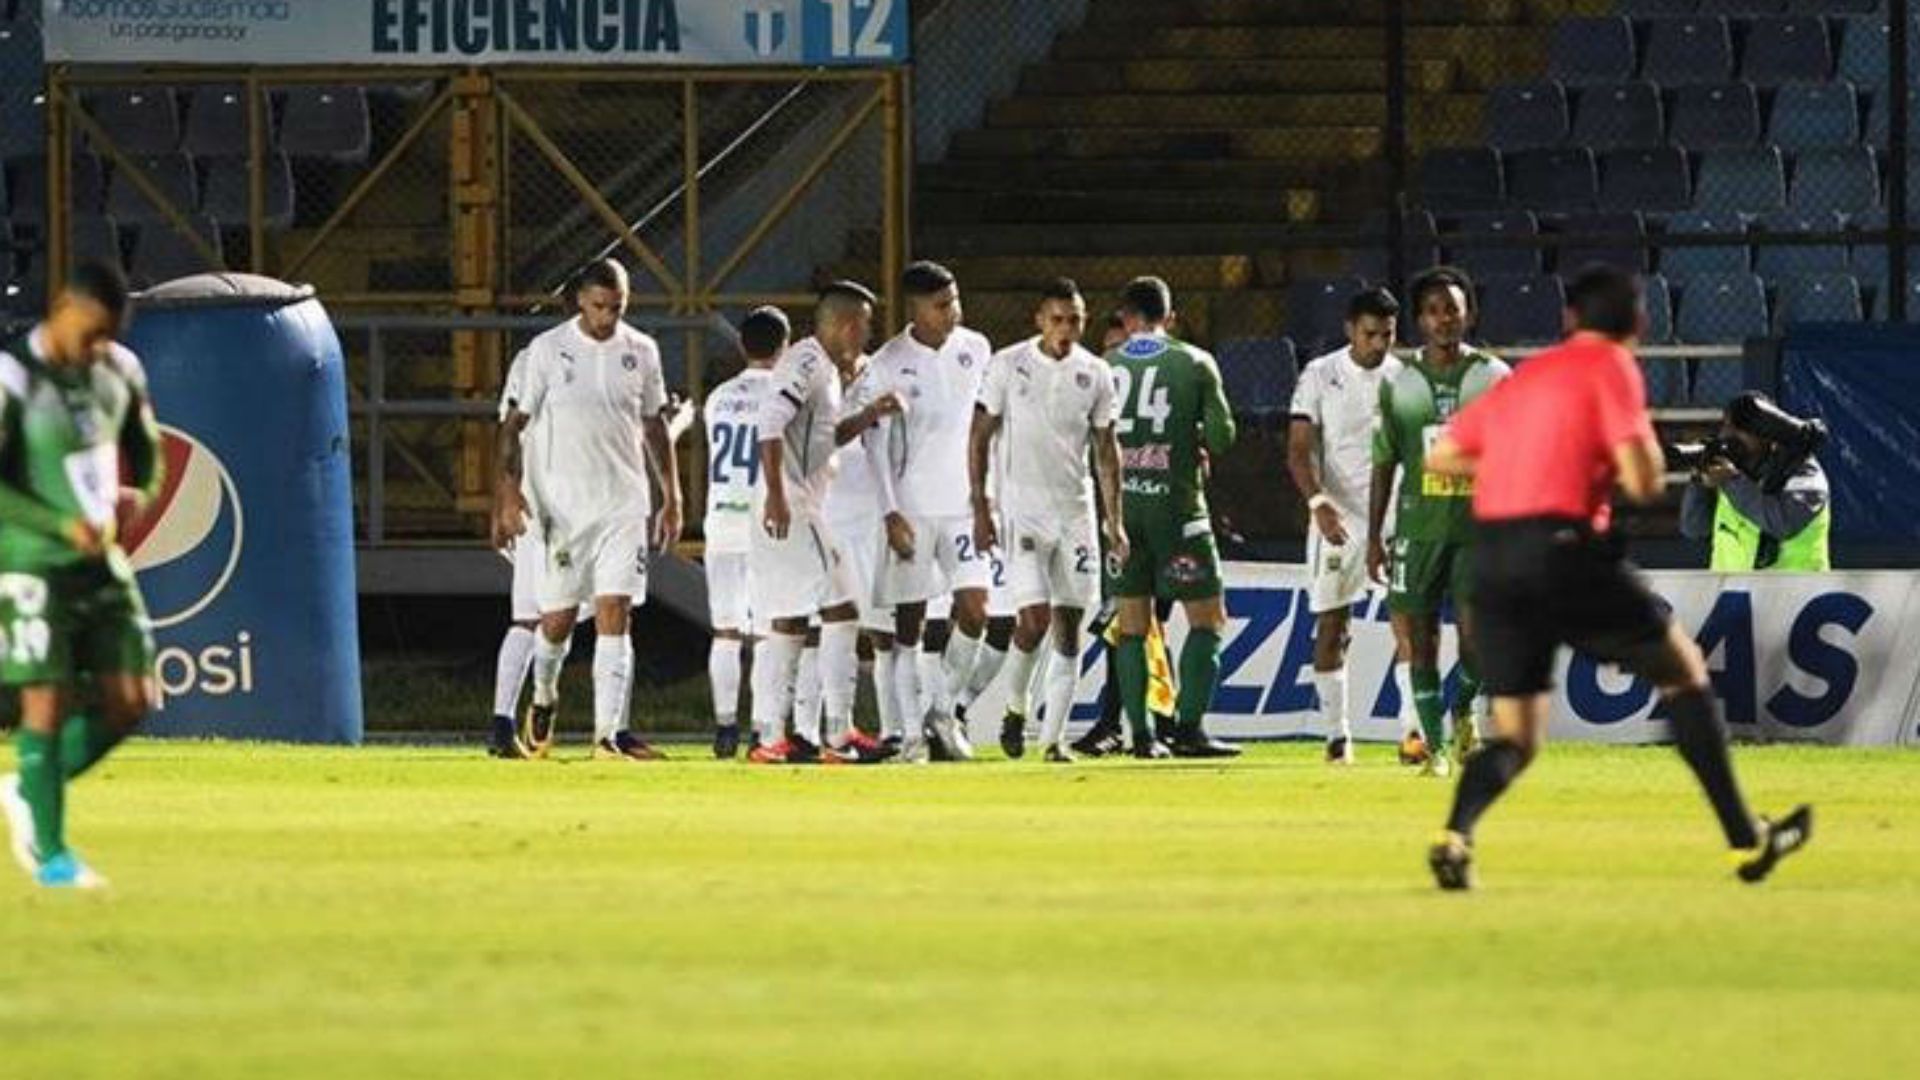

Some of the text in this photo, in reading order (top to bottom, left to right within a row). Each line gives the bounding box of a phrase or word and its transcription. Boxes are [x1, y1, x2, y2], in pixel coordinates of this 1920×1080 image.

[371, 0, 681, 54] EFICIENCIA
[822, 0, 893, 57] 12
[1111, 365, 1172, 434] 24
[713, 423, 759, 487] 24
